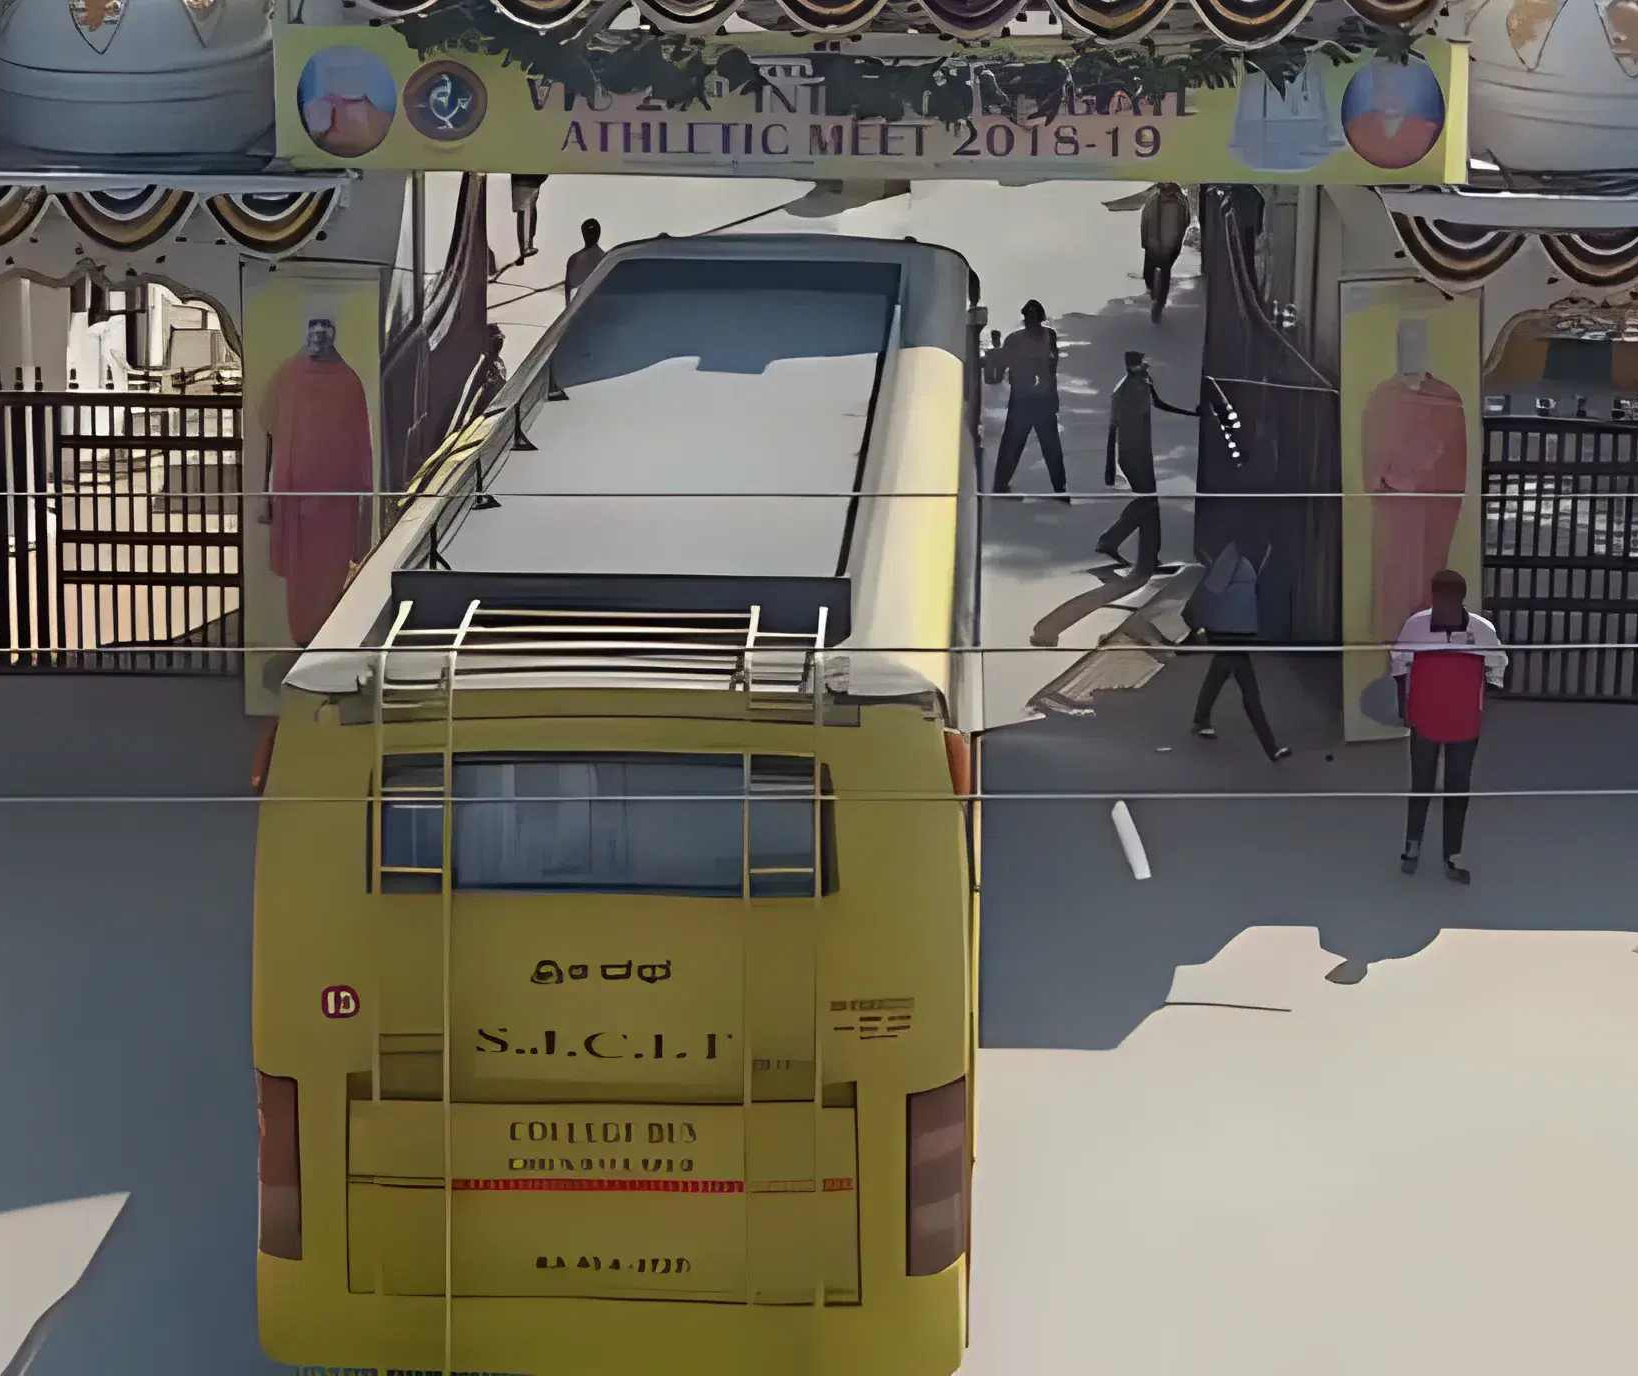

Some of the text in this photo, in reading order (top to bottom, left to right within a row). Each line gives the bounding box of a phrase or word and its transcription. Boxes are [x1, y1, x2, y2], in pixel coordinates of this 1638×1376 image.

[561, 120, 1161, 158] ATHLETIC MEET 2018-19
